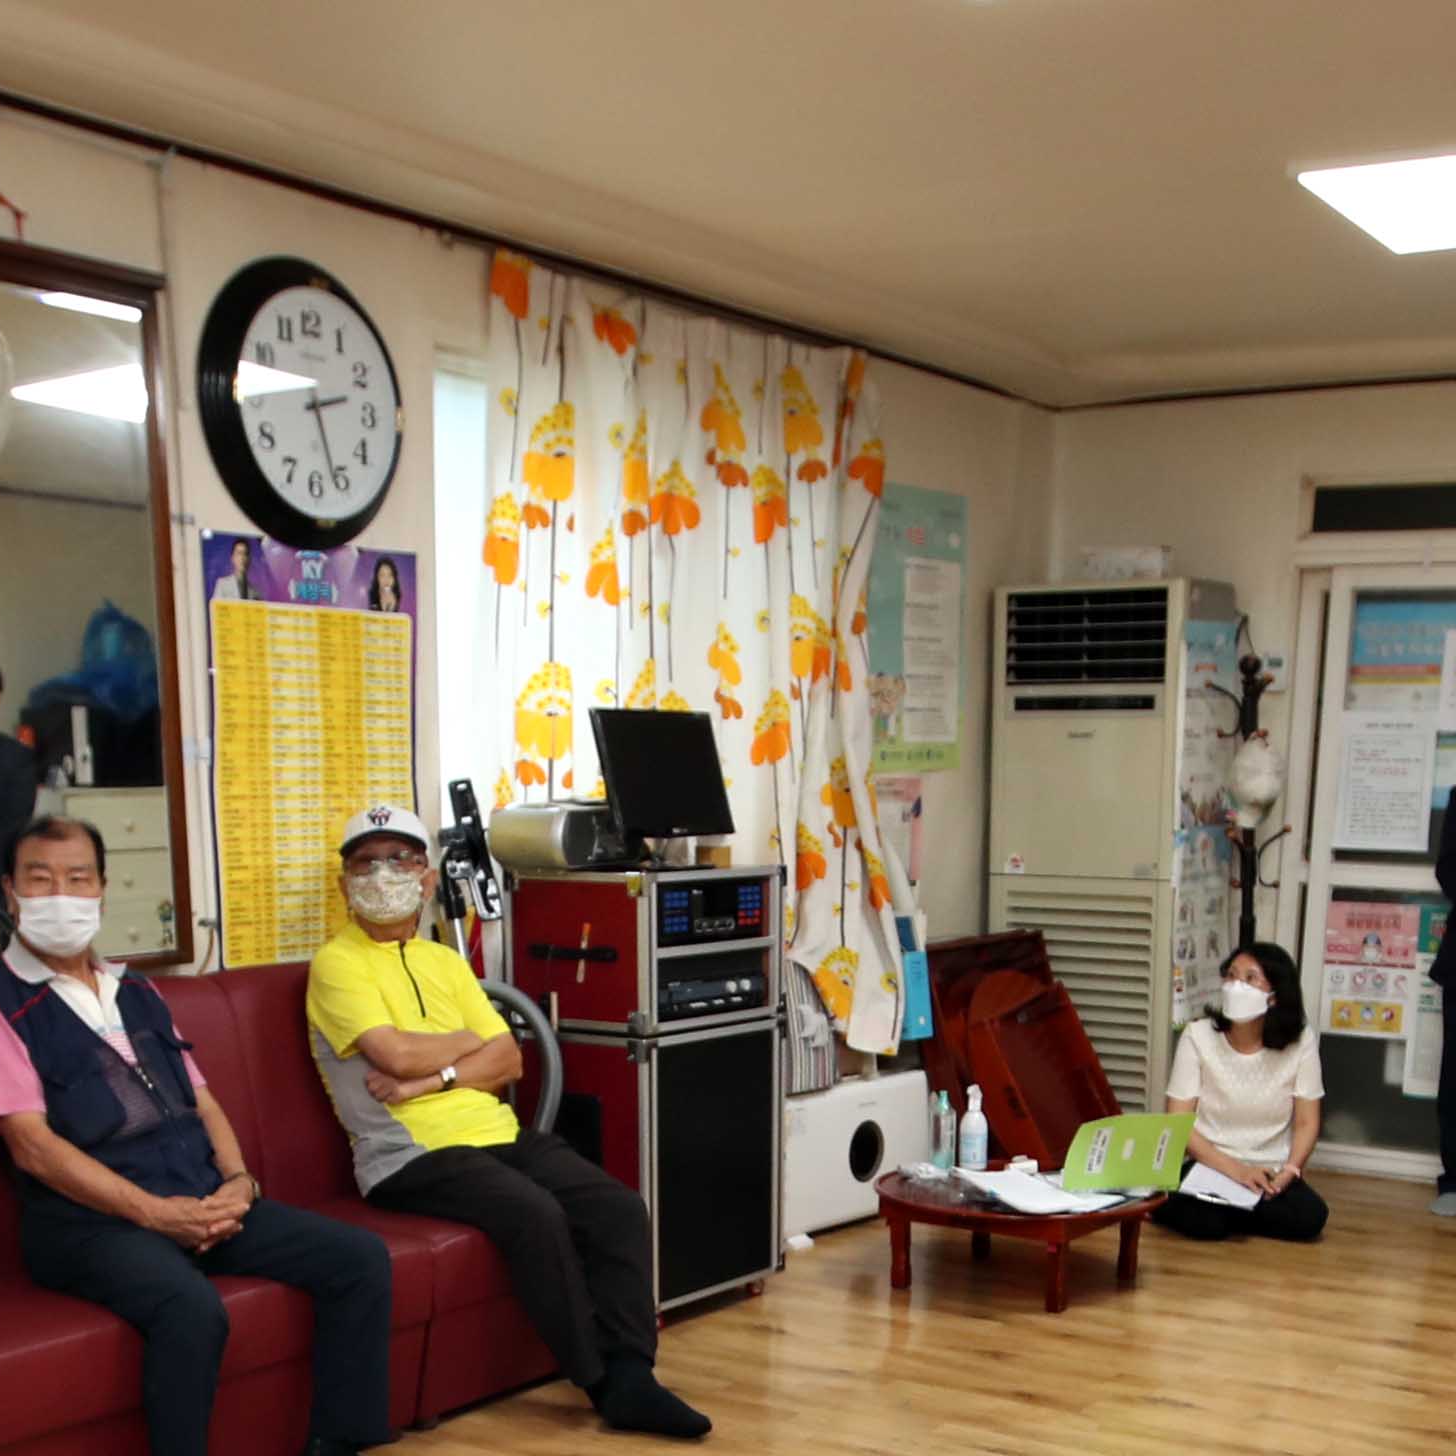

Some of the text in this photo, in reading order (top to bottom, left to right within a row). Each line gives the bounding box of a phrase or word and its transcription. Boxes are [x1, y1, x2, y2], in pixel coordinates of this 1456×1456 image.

[277, 314, 293, 342] 11
[300, 310, 321, 339] 12
[255, 341, 275, 366] 10
[336, 327, 344, 355] 1
[352, 361, 367, 389] 2
[361, 402, 376, 429] 3
[258, 421, 275, 450] 8
[352, 437, 368, 465] 4
[282, 456, 298, 484] 7
[334, 465, 350, 491] 5
[308, 470, 324, 499] 6
